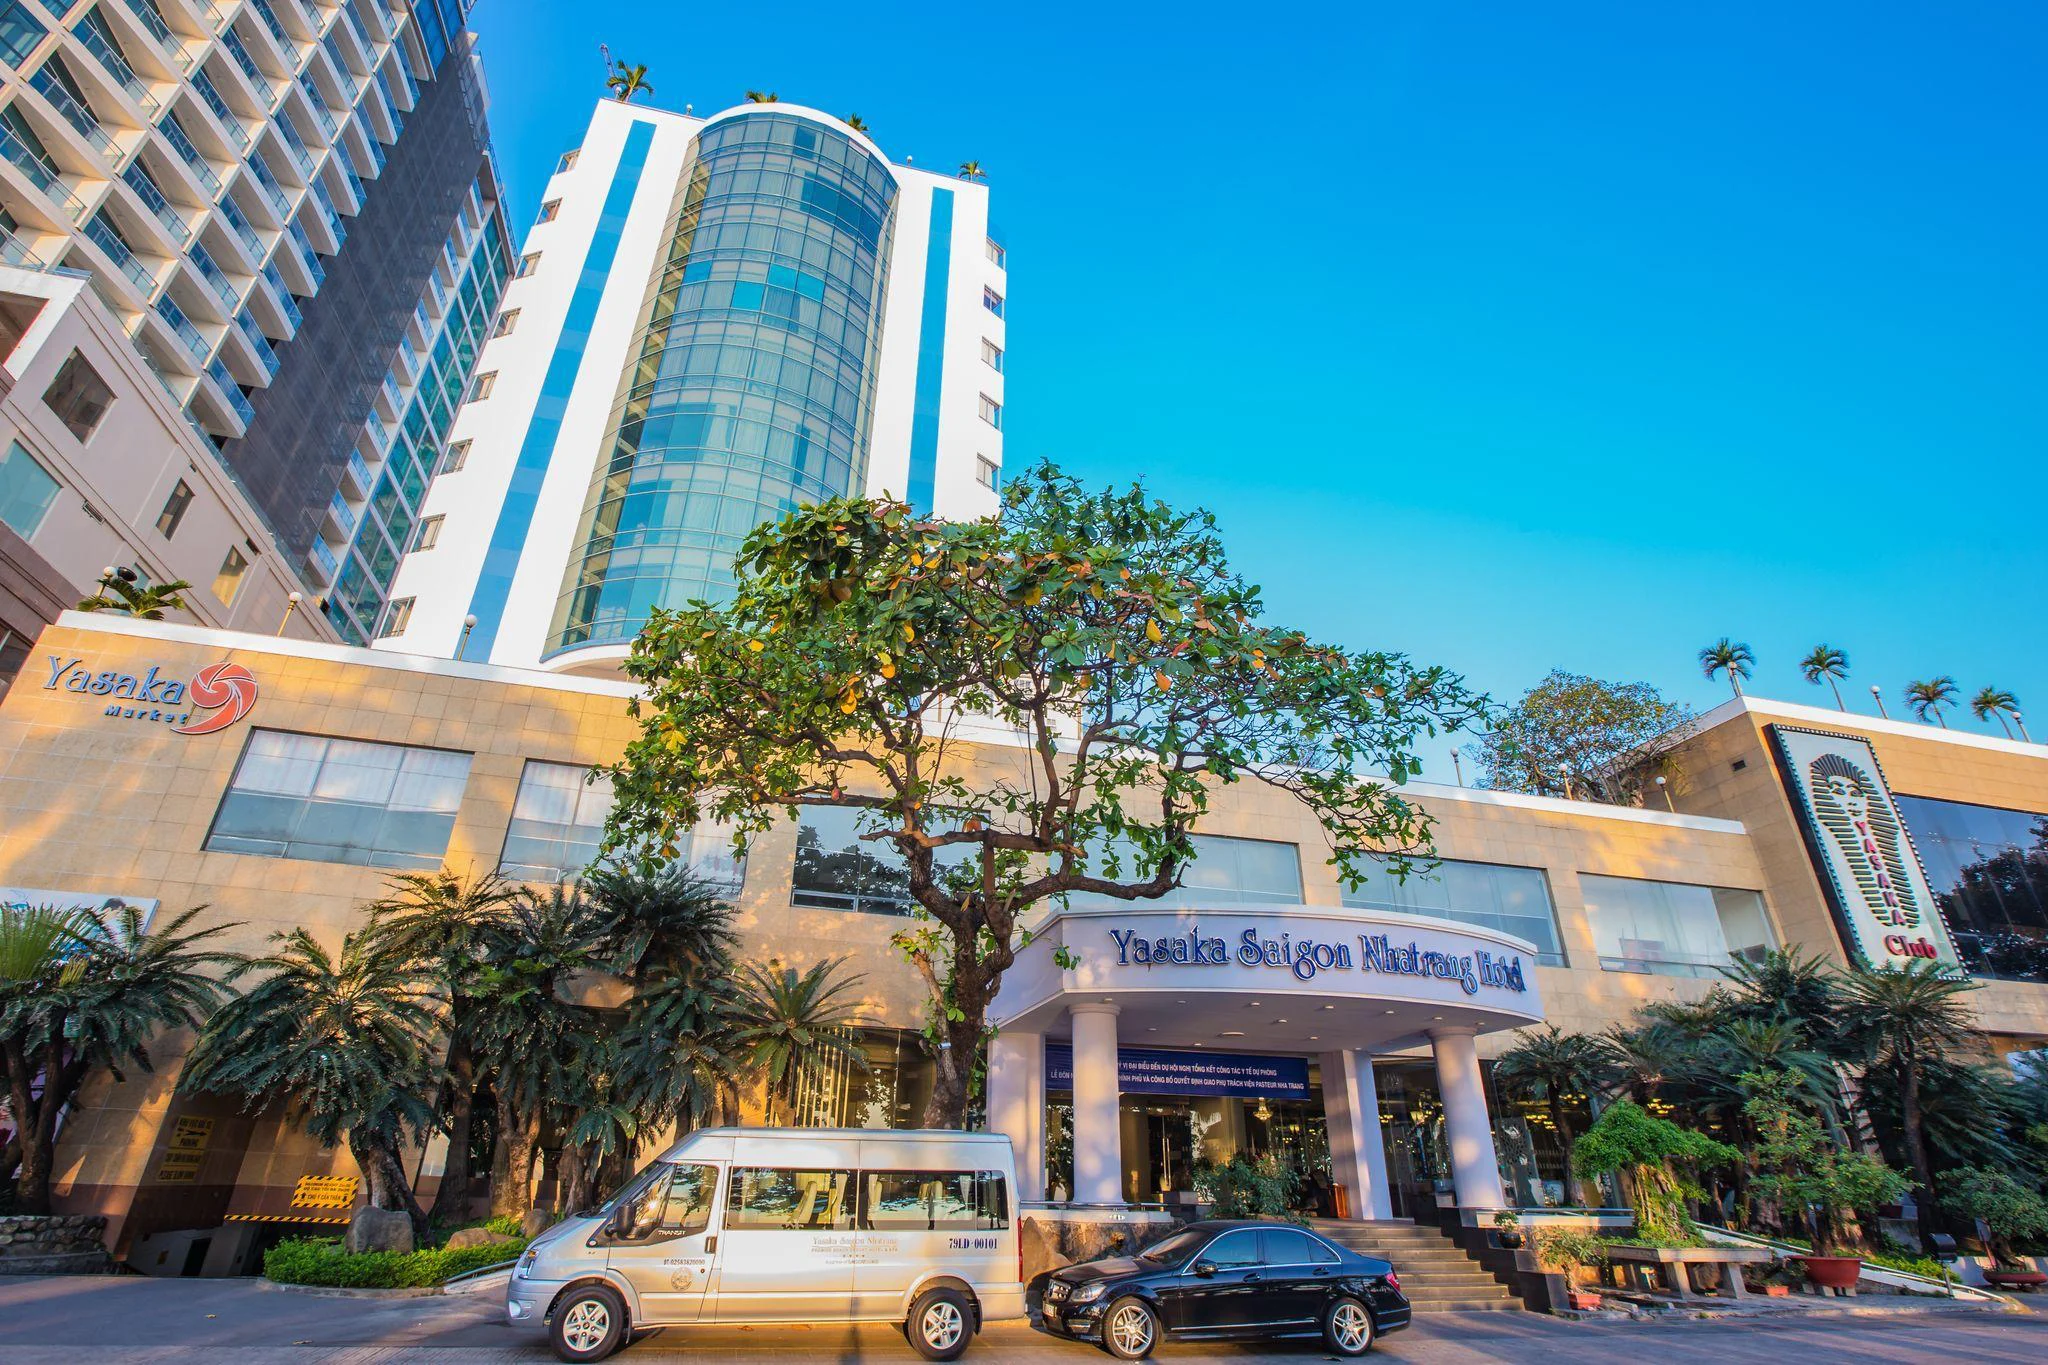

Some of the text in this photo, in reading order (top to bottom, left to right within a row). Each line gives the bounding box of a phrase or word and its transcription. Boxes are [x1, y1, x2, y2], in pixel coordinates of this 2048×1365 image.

[43, 655, 187, 704] Yasaka
[104, 703, 188, 724] Market
[1855, 821, 1907, 925] YASAKA
[1108, 926, 1526, 995] Yasaka Saigon Nhatrang Hotel
[1884, 934, 1938, 959] Club
